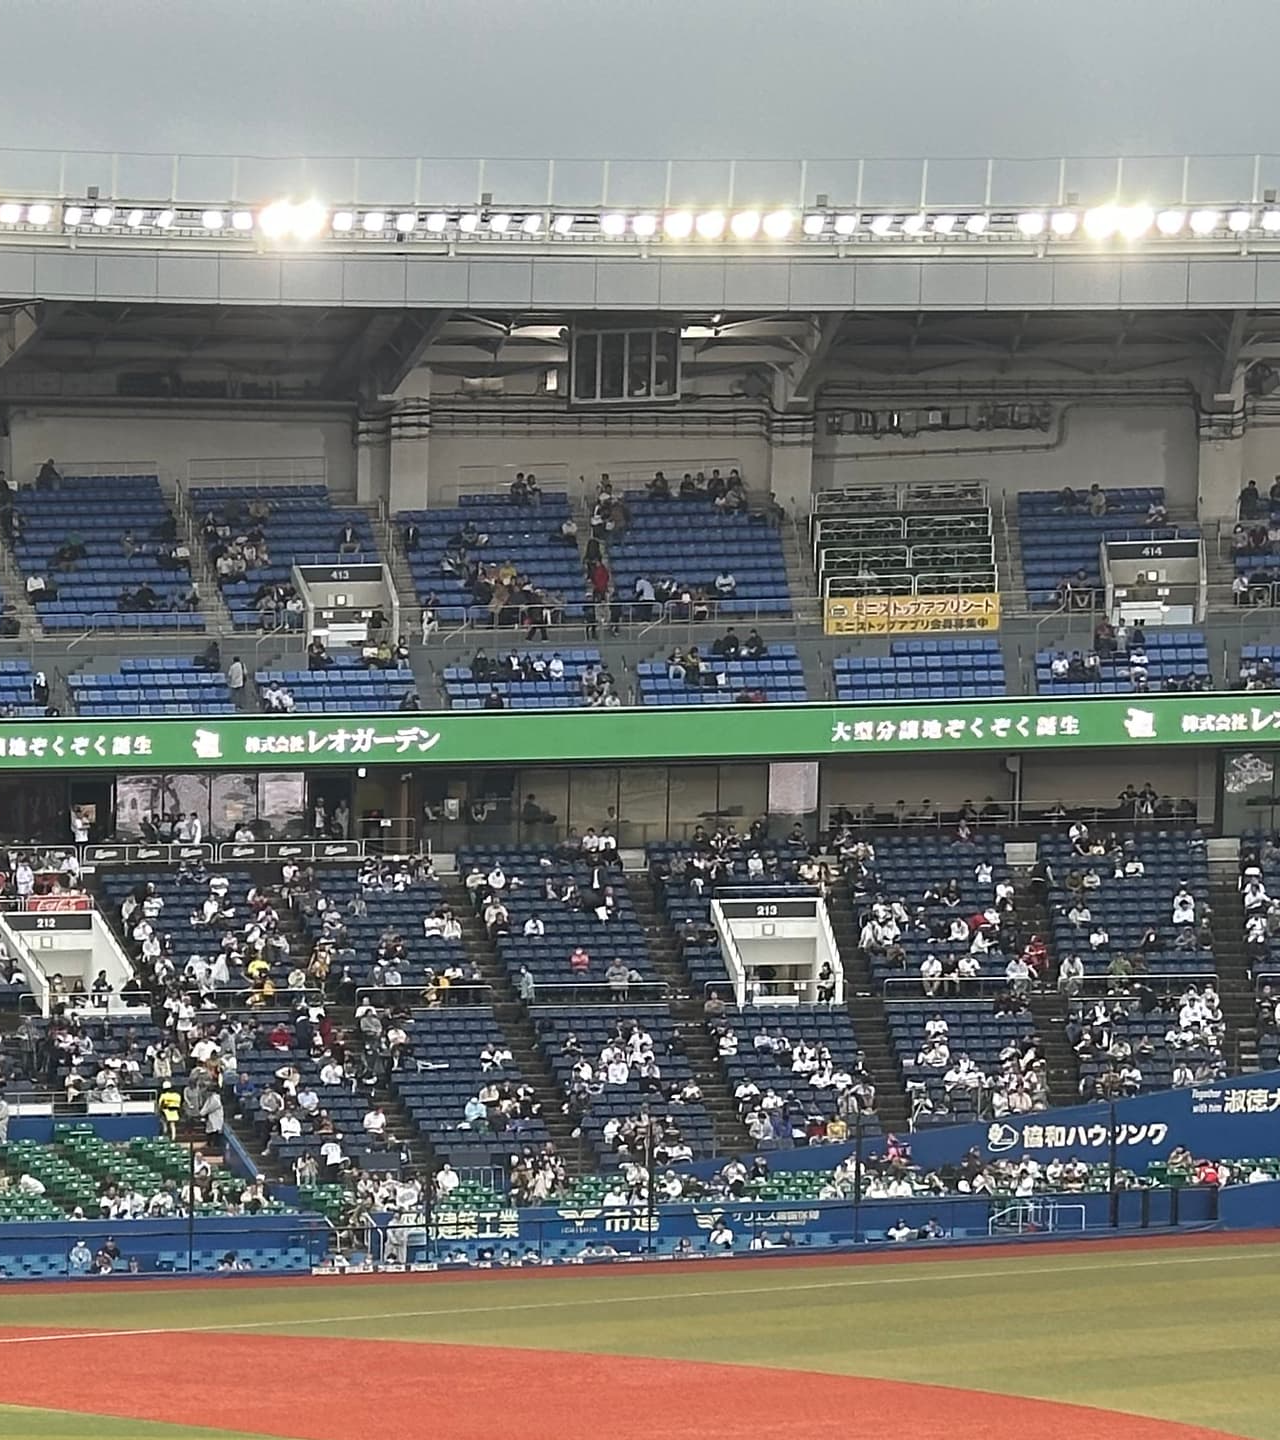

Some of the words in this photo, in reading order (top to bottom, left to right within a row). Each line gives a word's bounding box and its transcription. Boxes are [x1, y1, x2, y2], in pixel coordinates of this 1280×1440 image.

[1142, 545, 1162, 556] 414
[330, 570, 350, 580] 413
[245, 729, 441, 753] 株式会社レオガーデン
[756, 905, 777, 916] 213
[36, 917, 56, 928] 212
